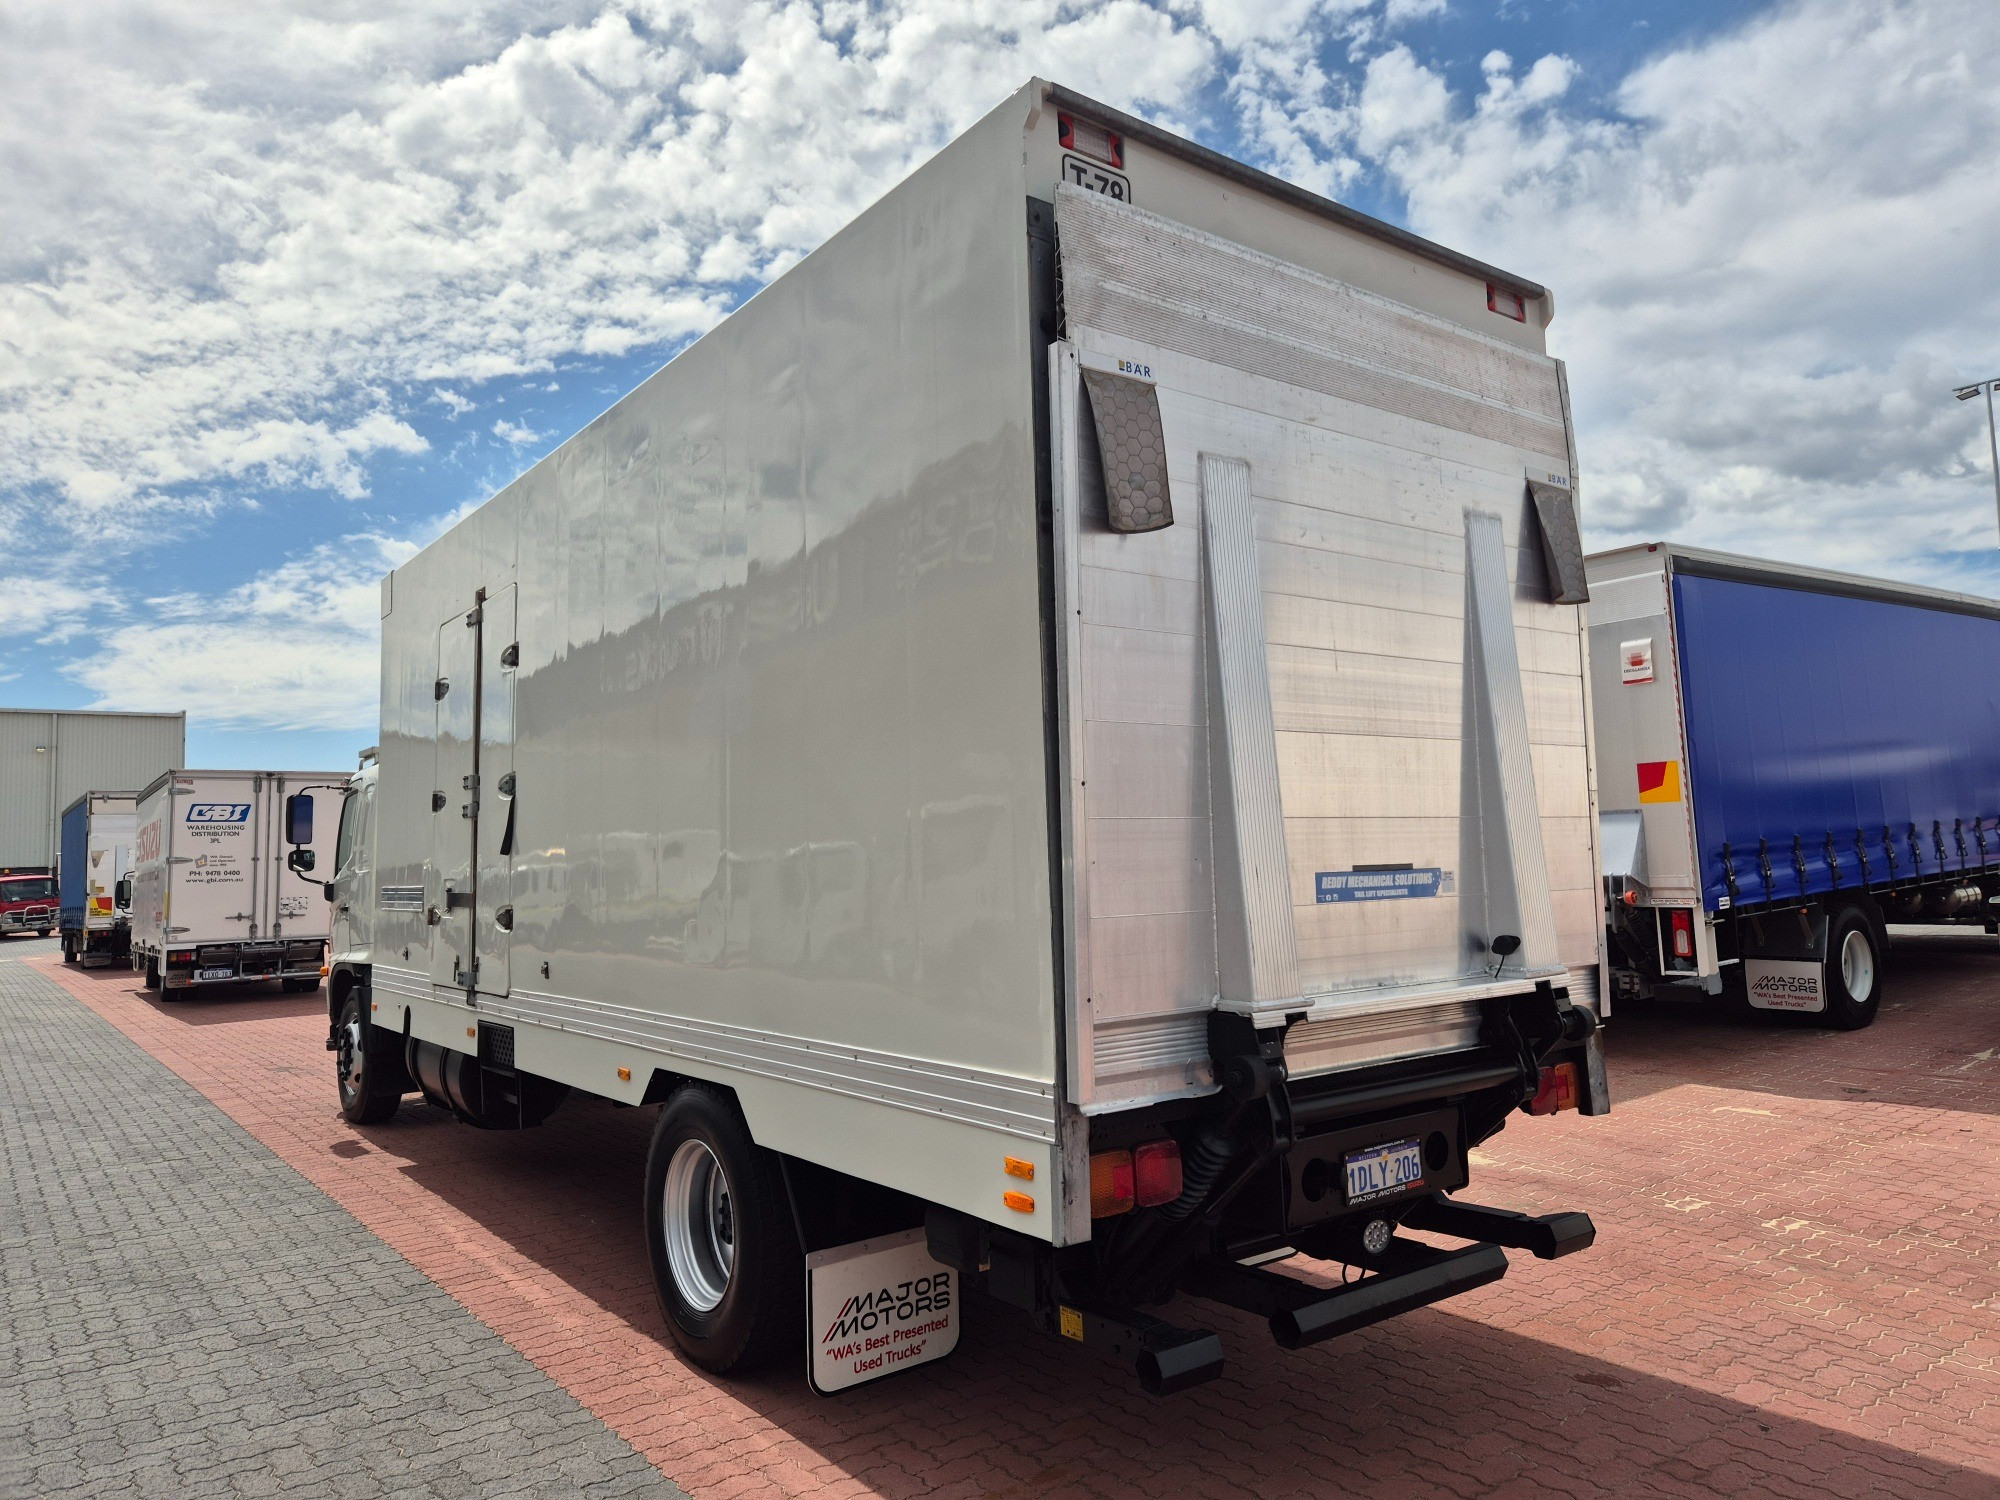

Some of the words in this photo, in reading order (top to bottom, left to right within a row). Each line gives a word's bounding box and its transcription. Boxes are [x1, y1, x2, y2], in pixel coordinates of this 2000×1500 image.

[1125, 361, 1151, 378] BÄR
[189, 805, 249, 821] GBI
[1321, 876, 1347, 889] REDDY
[1347, 874, 1394, 888] MECHANICAL
[1394, 872, 1433, 886] SOLUTIONS
[1354, 890, 1365, 898] TAIL
[1365, 890, 1377, 898] LIFT
[1376, 888, 1409, 897] SPECIALISTS
[1751, 982, 1819, 994] MOTORS
[1757, 975, 1818, 986] MAJOR
[1787, 994, 1818, 1002] Presented
[1349, 1192, 1377, 1206] MAJOR
[1378, 1184, 1407, 1198] MOTORS
[1407, 1179, 1425, 1189] ISUZU
[836, 1272, 950, 1319] MAJOR
[822, 1290, 951, 1344] MOTORS
[865, 1333, 890, 1352] Best
[893, 1314, 949, 1343] Presented
[853, 1353, 883, 1374] Used
[885, 1339, 927, 1364] Trucks"
